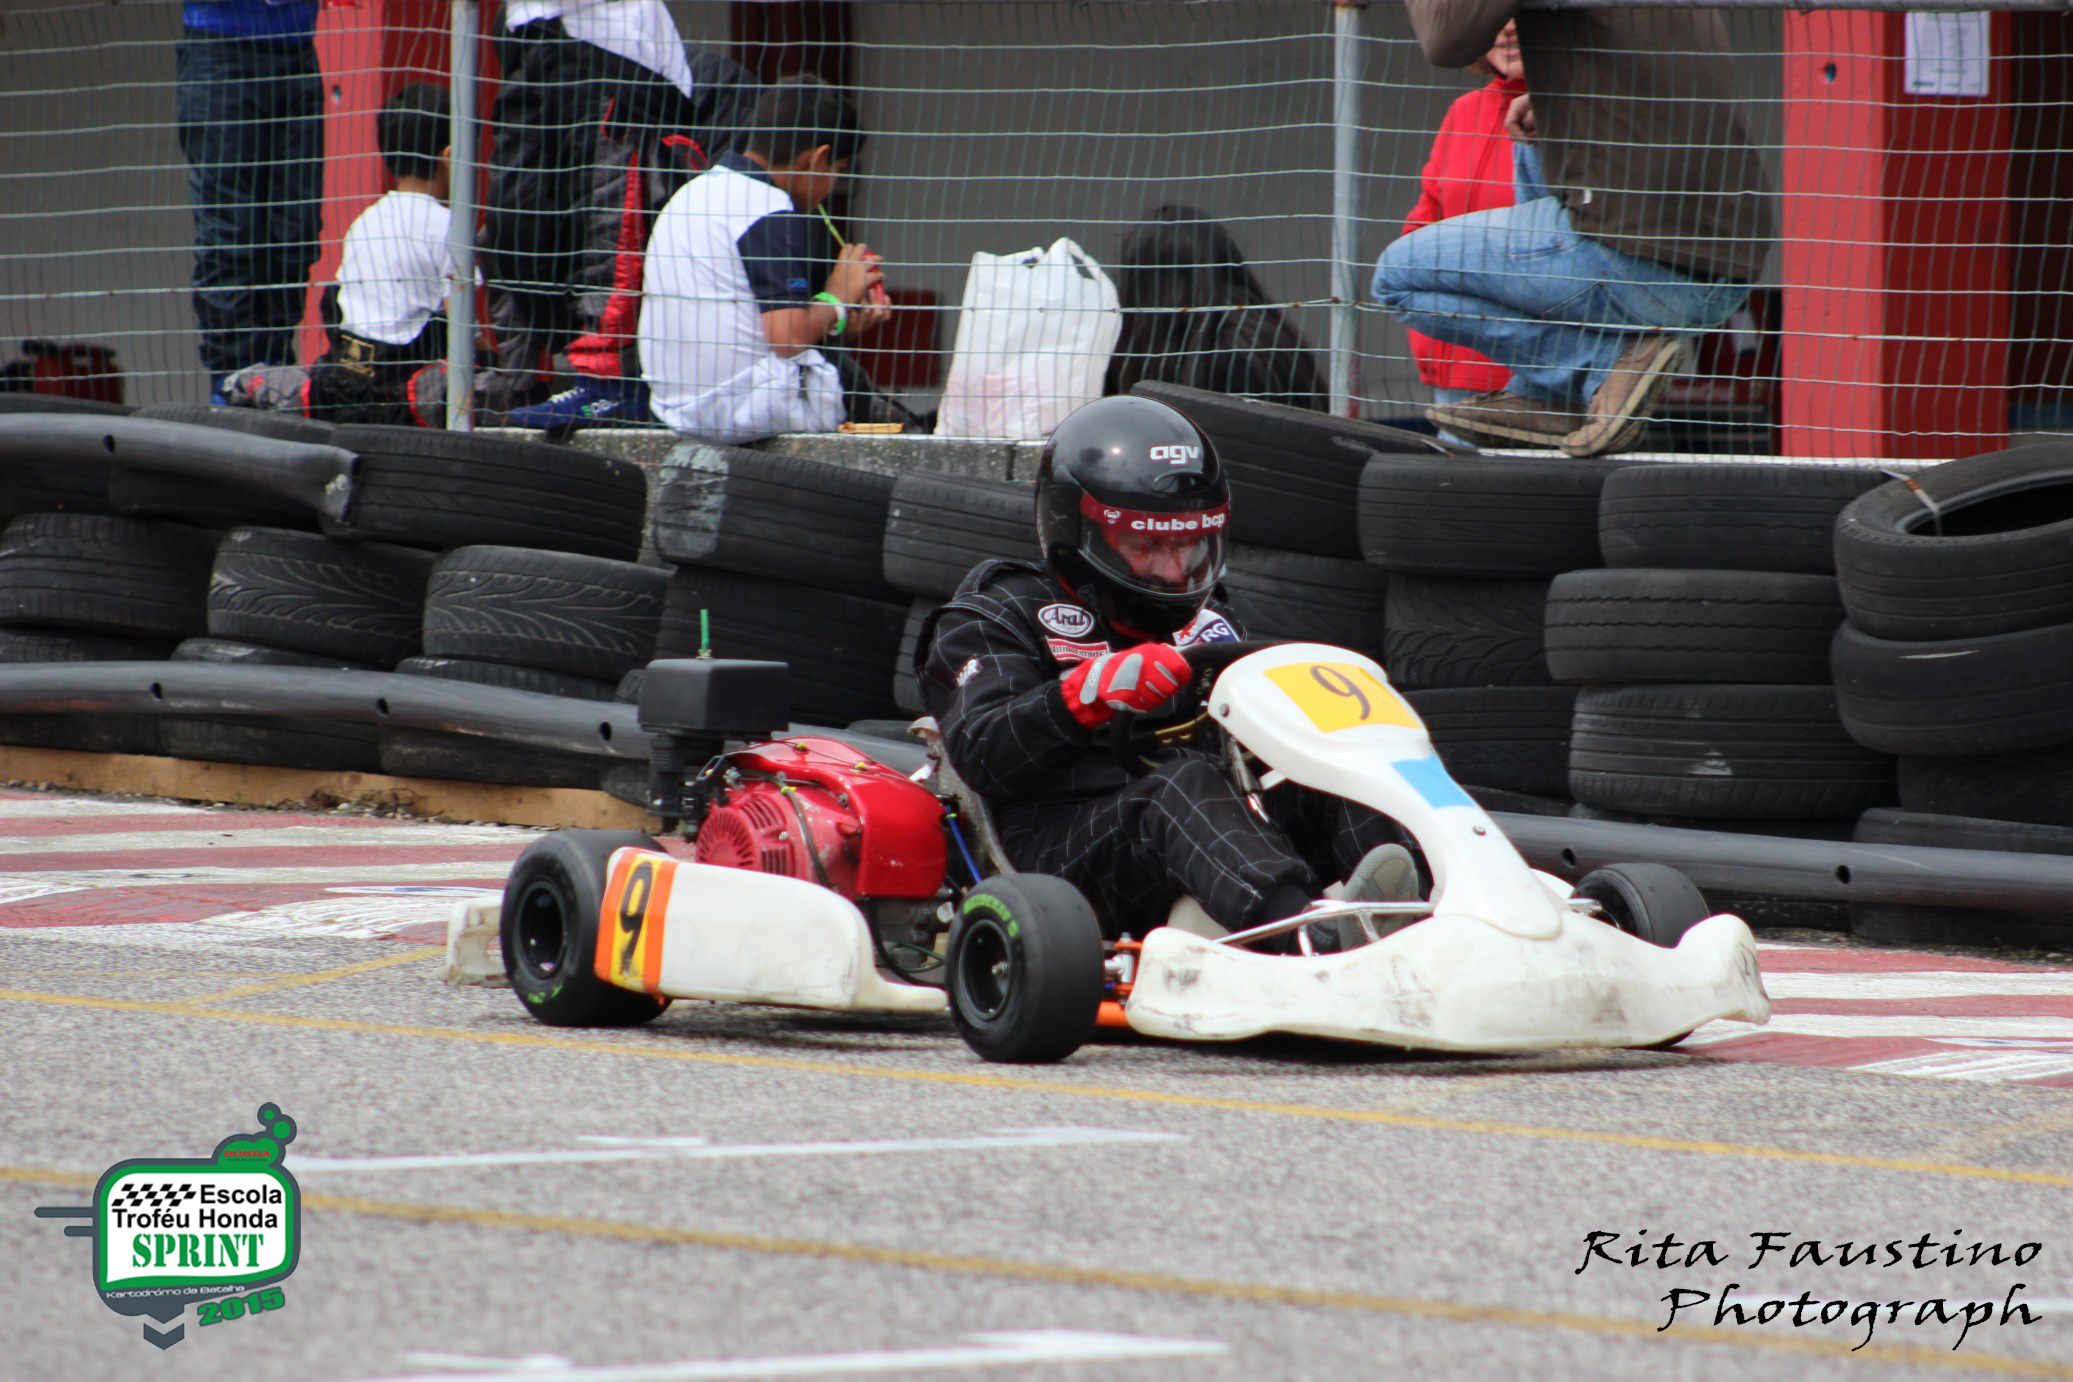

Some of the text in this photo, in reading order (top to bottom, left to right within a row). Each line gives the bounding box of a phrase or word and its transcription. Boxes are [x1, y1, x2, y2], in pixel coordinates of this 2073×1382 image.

[1151, 446, 1198, 464] agv
[1131, 513, 1225, 531] clube bcp
[1310, 665, 1371, 721] 9
[620, 860, 653, 975] 9
